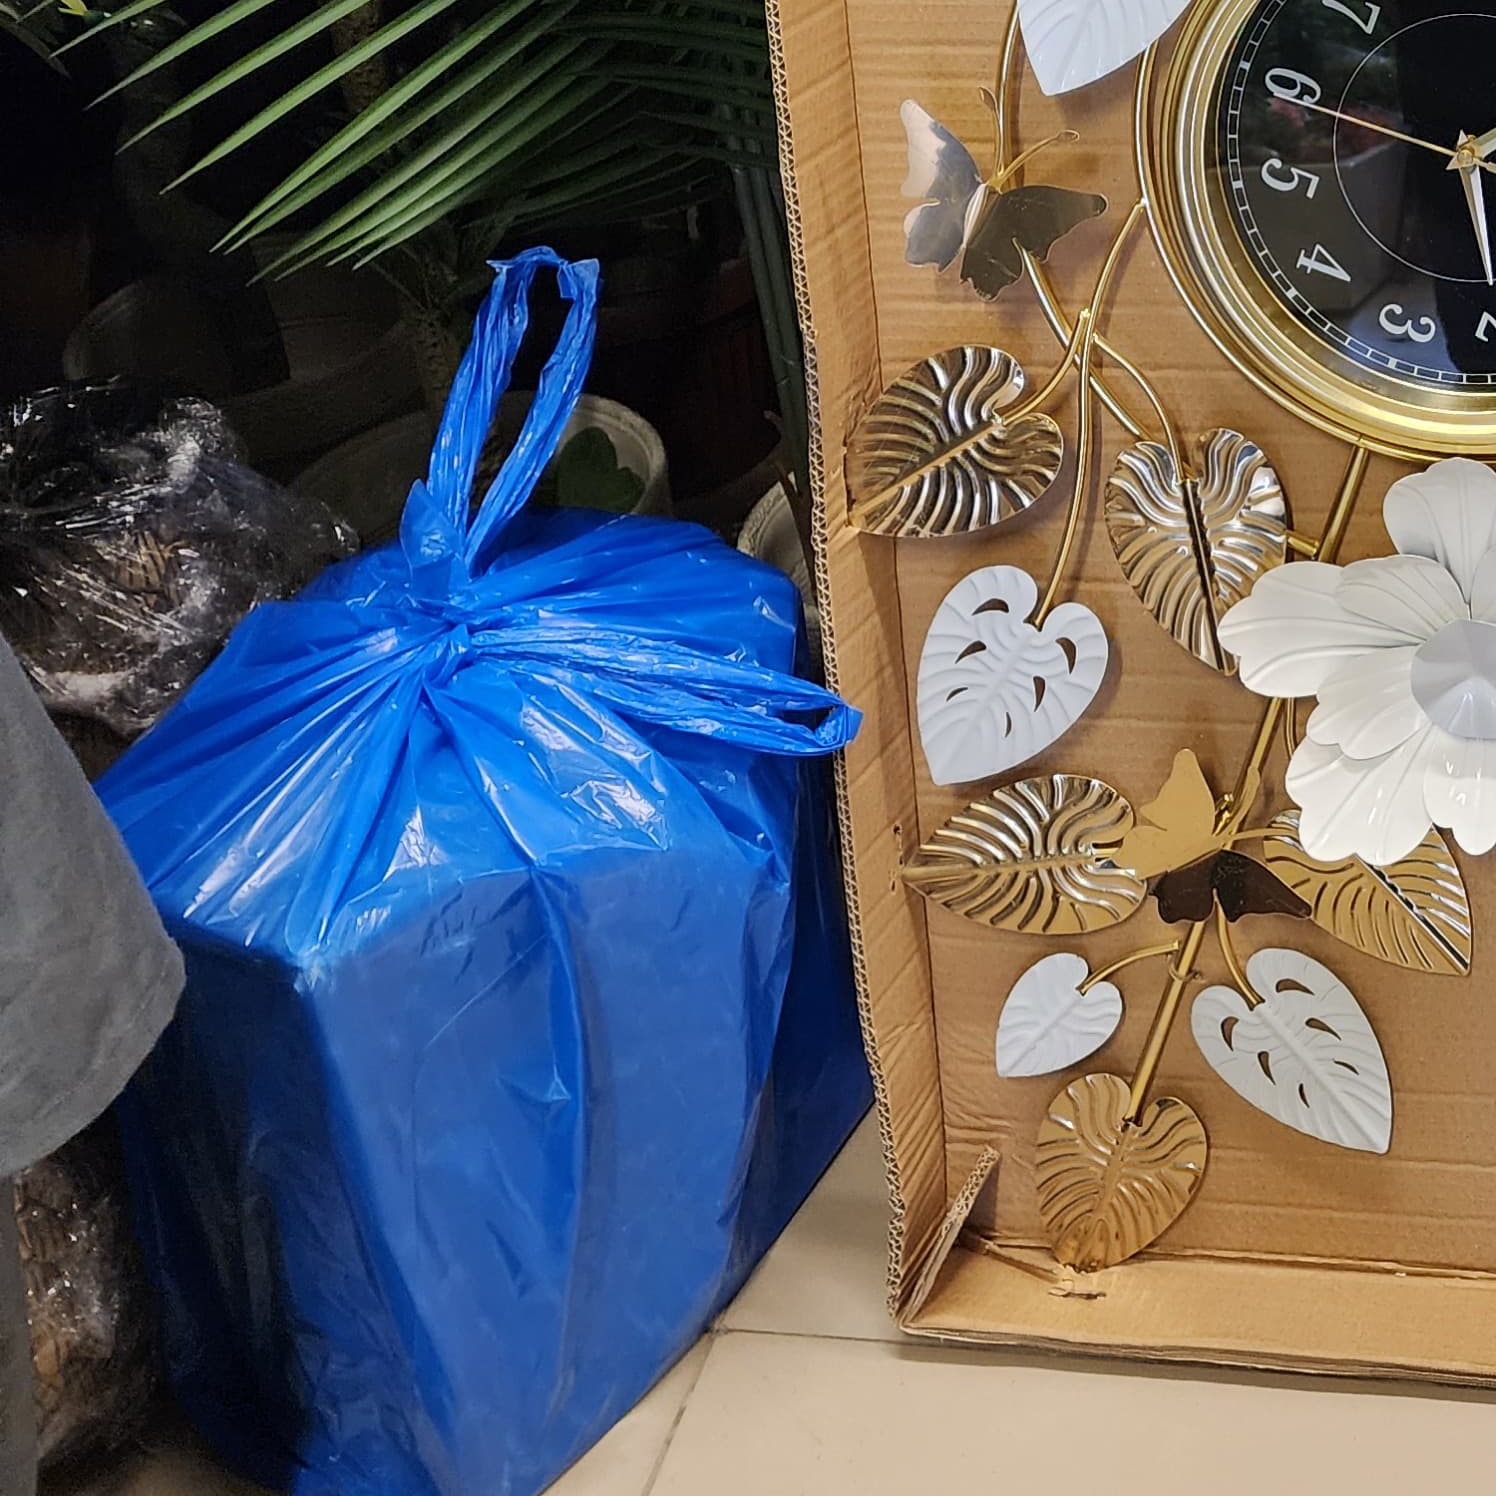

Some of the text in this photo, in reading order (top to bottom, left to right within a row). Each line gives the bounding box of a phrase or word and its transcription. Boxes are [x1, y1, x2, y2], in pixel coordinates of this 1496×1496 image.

[1264, 68, 1321, 105] 6
[1261, 158, 1320, 199] 5
[1297, 243, 1352, 283] 4
[1379, 304, 1436, 342] 3
